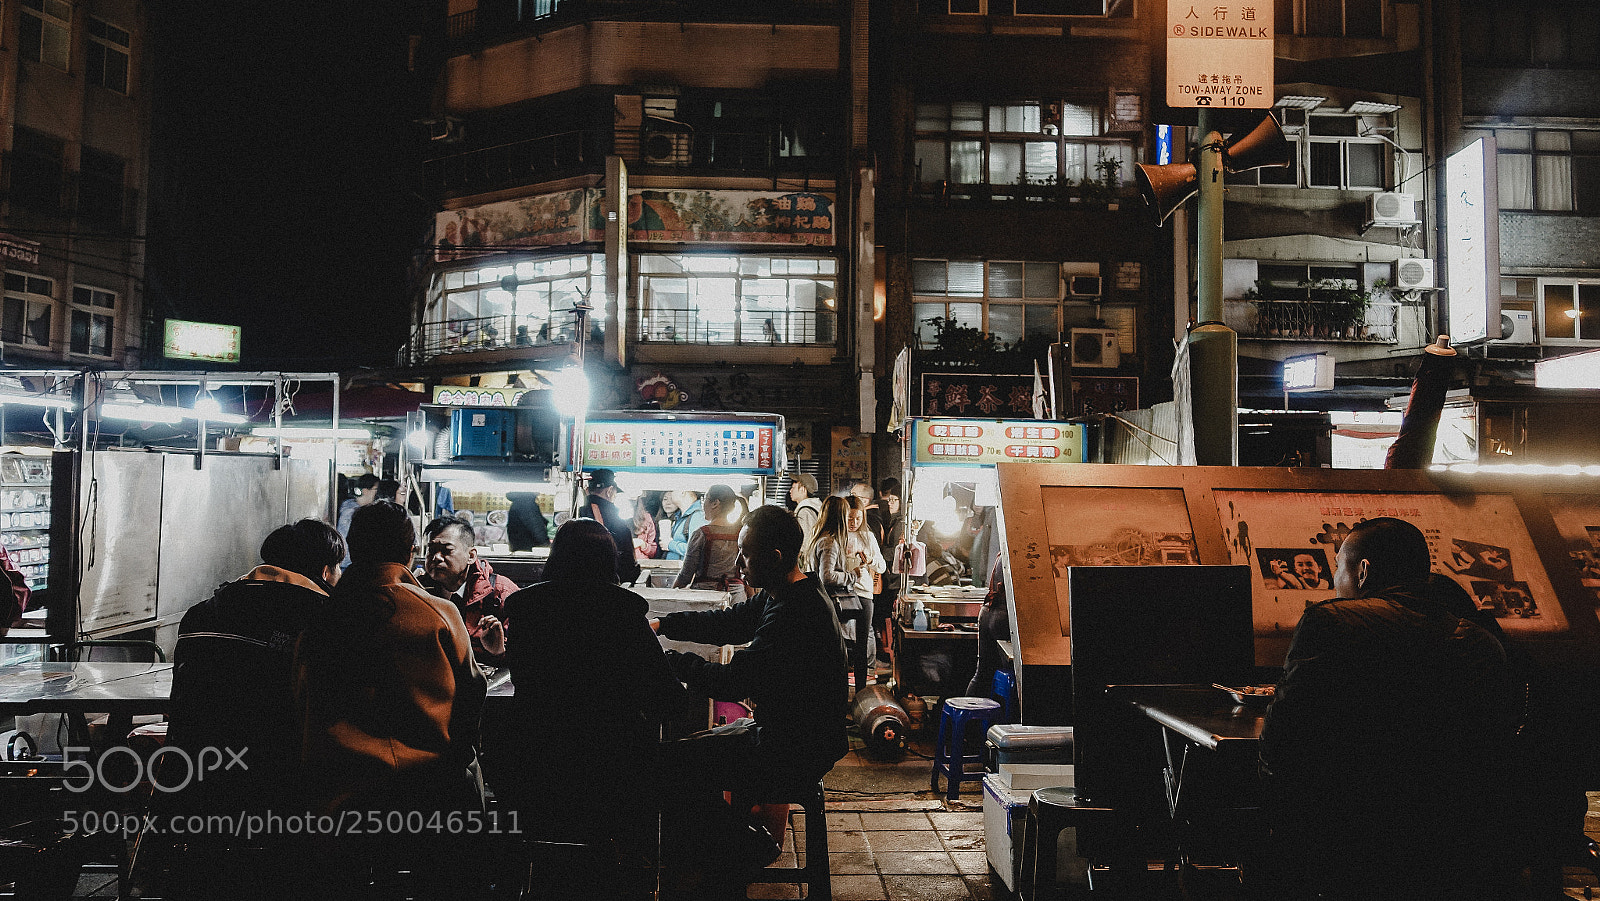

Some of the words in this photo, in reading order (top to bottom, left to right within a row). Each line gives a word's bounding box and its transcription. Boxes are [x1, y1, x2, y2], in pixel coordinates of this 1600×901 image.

[1185, 5, 1256, 21] 人行道
[1190, 26, 1268, 38] SIDEWALK
[1198, 73, 1243, 85] 違者拖吊
[1178, 85, 1232, 95] TOW-AWAY
[1235, 86, 1263, 96] ZONE
[1221, 96, 1245, 106] 110
[1061, 430, 1074, 439] 100
[986, 446, 995, 455] 70
[1062, 448, 1072, 457] 40
